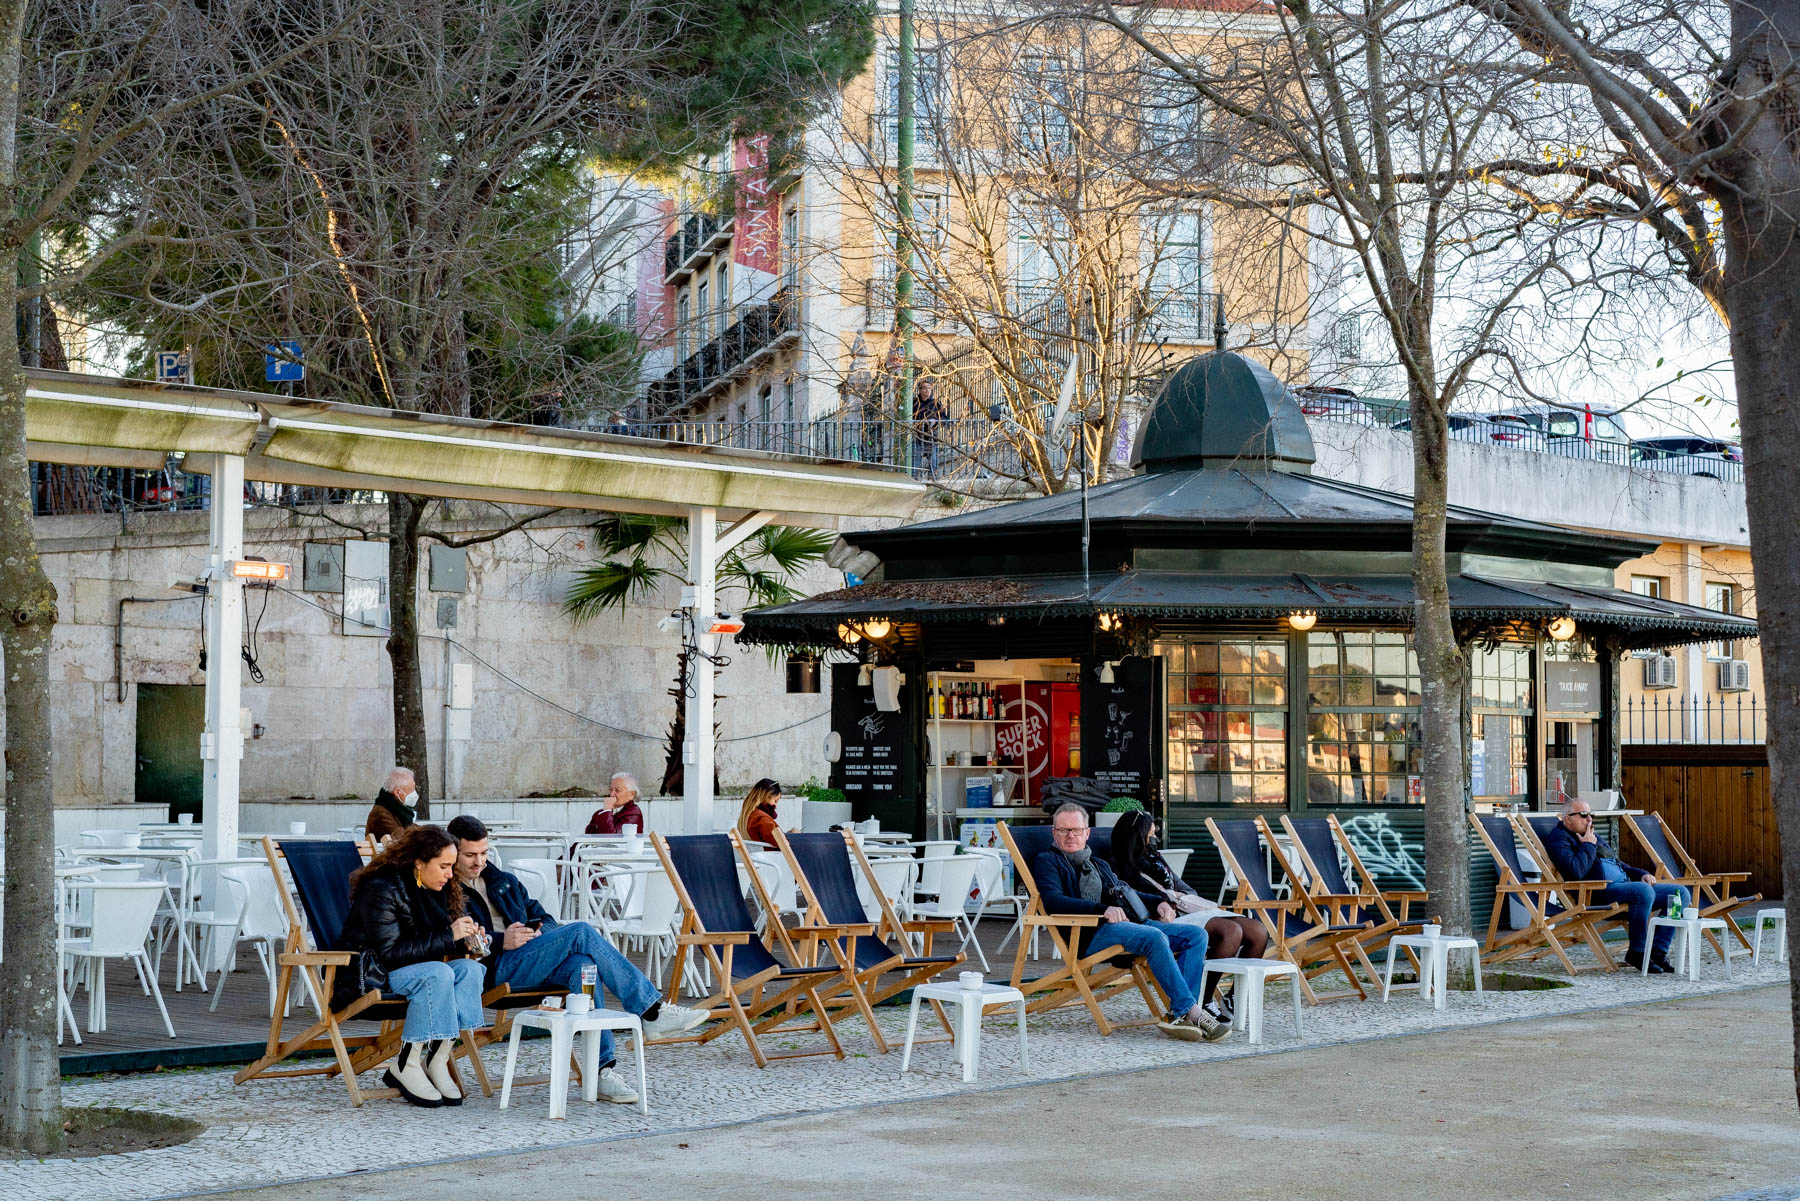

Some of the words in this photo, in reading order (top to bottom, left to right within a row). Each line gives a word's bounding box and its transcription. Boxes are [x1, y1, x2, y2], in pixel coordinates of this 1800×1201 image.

[163, 356, 177, 377] P
[273, 346, 293, 374] P
[1559, 681, 1573, 691] TAKE
[1574, 682, 1588, 692] AWAY
[997, 715, 1042, 748] SUPER
